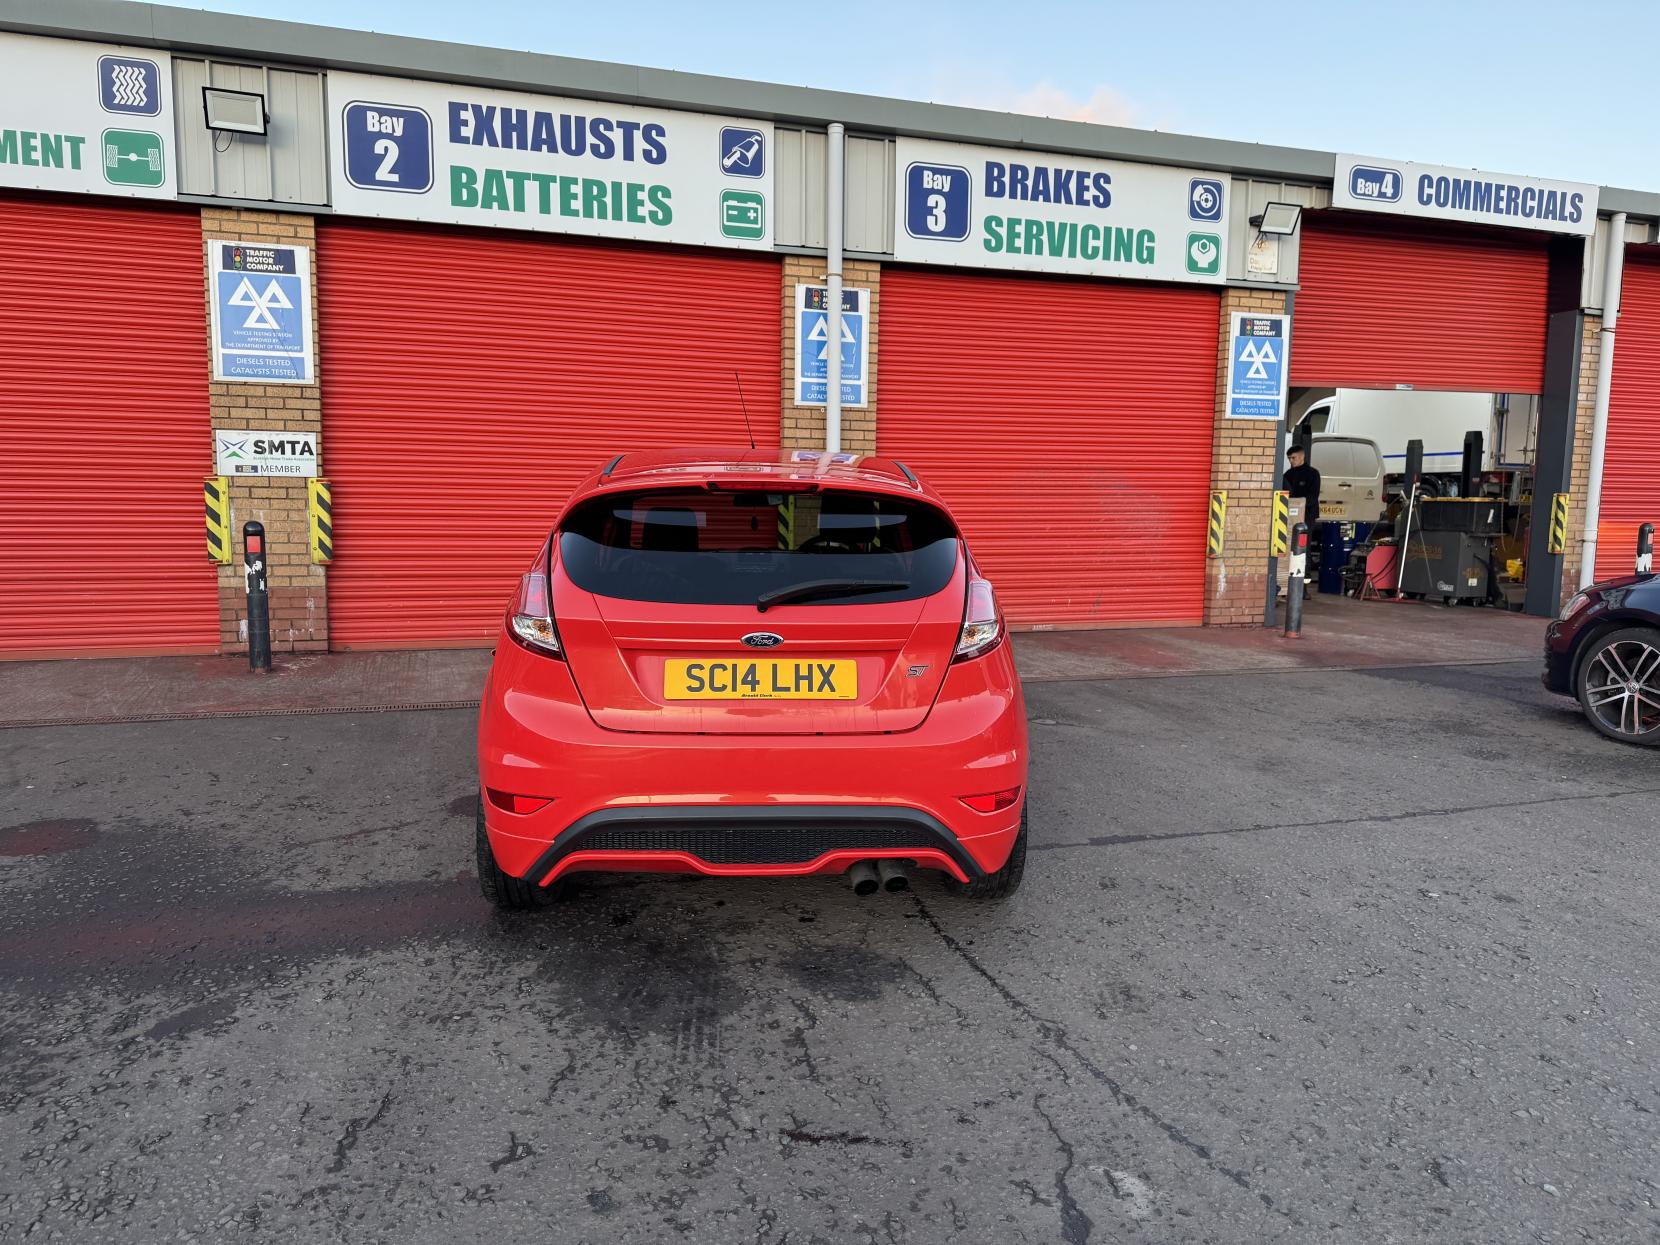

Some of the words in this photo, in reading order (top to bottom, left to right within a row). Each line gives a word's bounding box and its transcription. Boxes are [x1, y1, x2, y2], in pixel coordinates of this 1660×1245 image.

[366, 110, 404, 137] Bay
[447, 101, 668, 166] EXHAUSTS
[0, 129, 86, 171] MENT
[374, 139, 400, 183] 2
[922, 170, 952, 192] Bay
[984, 160, 1112, 209] BRAKES
[1356, 177, 1381, 198] Bay
[1381, 172, 1394, 198] 4
[448, 164, 674, 227] BATTERIES
[1417, 174, 1584, 224] COMMERCIALS
[926, 193, 947, 233] 3
[982, 214, 1156, 265] SERVICING
[245, 249, 275, 257] TRAFFIC
[246, 263, 284, 272] COMPANY
[231, 366, 270, 375] CATALYSTS
[271, 368, 297, 376] TESTED
[236, 357, 264, 365] DIESELS
[265, 358, 291, 366] TESTED
[253, 439, 315, 456] SMTA
[260, 465, 301, 473] MEMBER
[750, 634, 774, 645] Ford
[686, 663, 760, 692] SC14
[771, 663, 836, 692] LHX
[906, 665, 929, 678] ST
